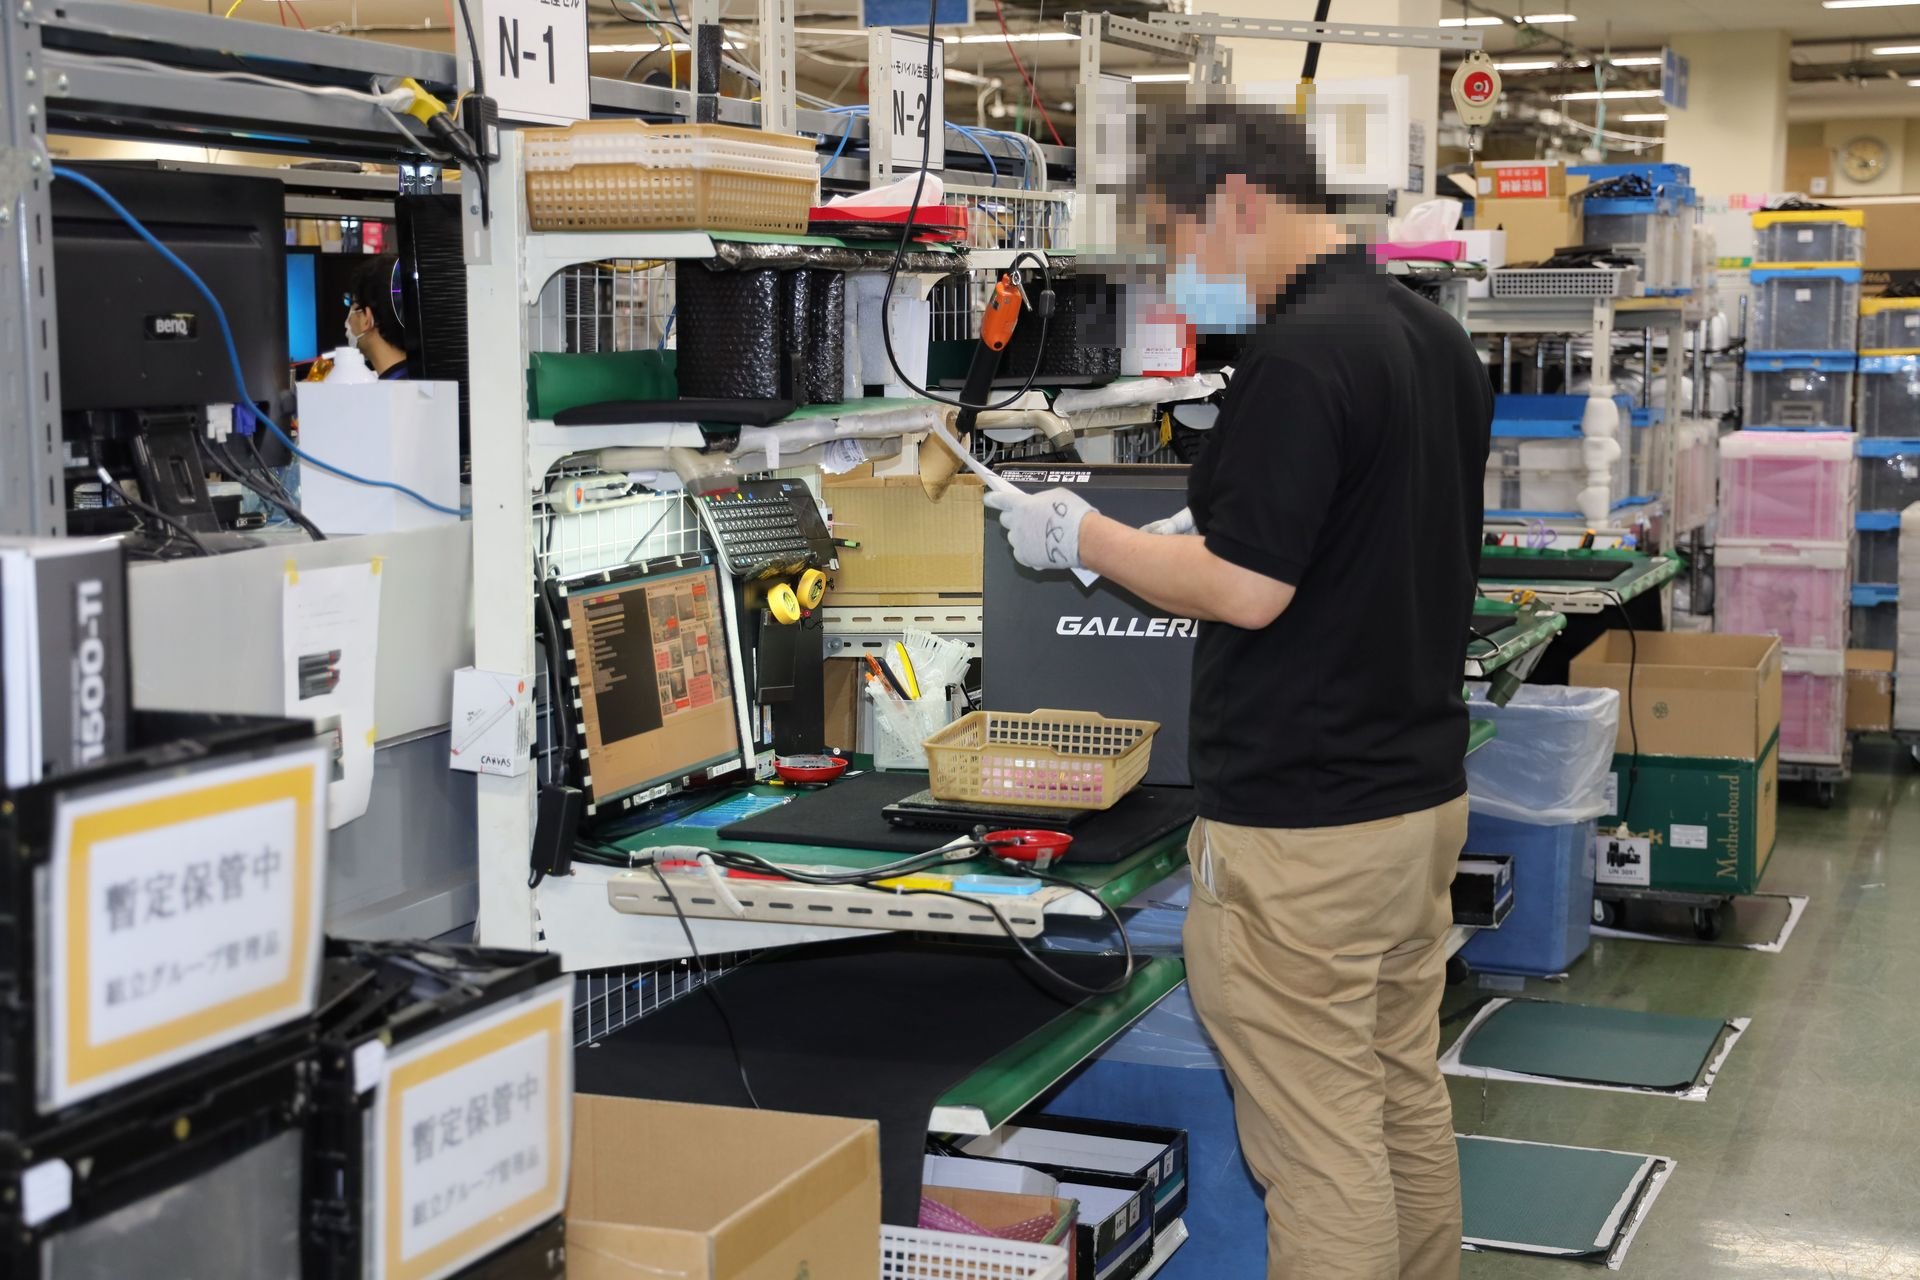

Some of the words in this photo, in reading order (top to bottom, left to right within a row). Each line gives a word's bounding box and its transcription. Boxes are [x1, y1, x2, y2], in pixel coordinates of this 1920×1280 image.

[498, 16, 555, 84] N-1
[893, 89, 928, 137] N-2
[156, 319, 188, 335] BenQ
[480, 755, 512, 768] CANVAS
[1716, 774, 1740, 881] Motherboard
[106, 843, 281, 934] 暫定保管中
